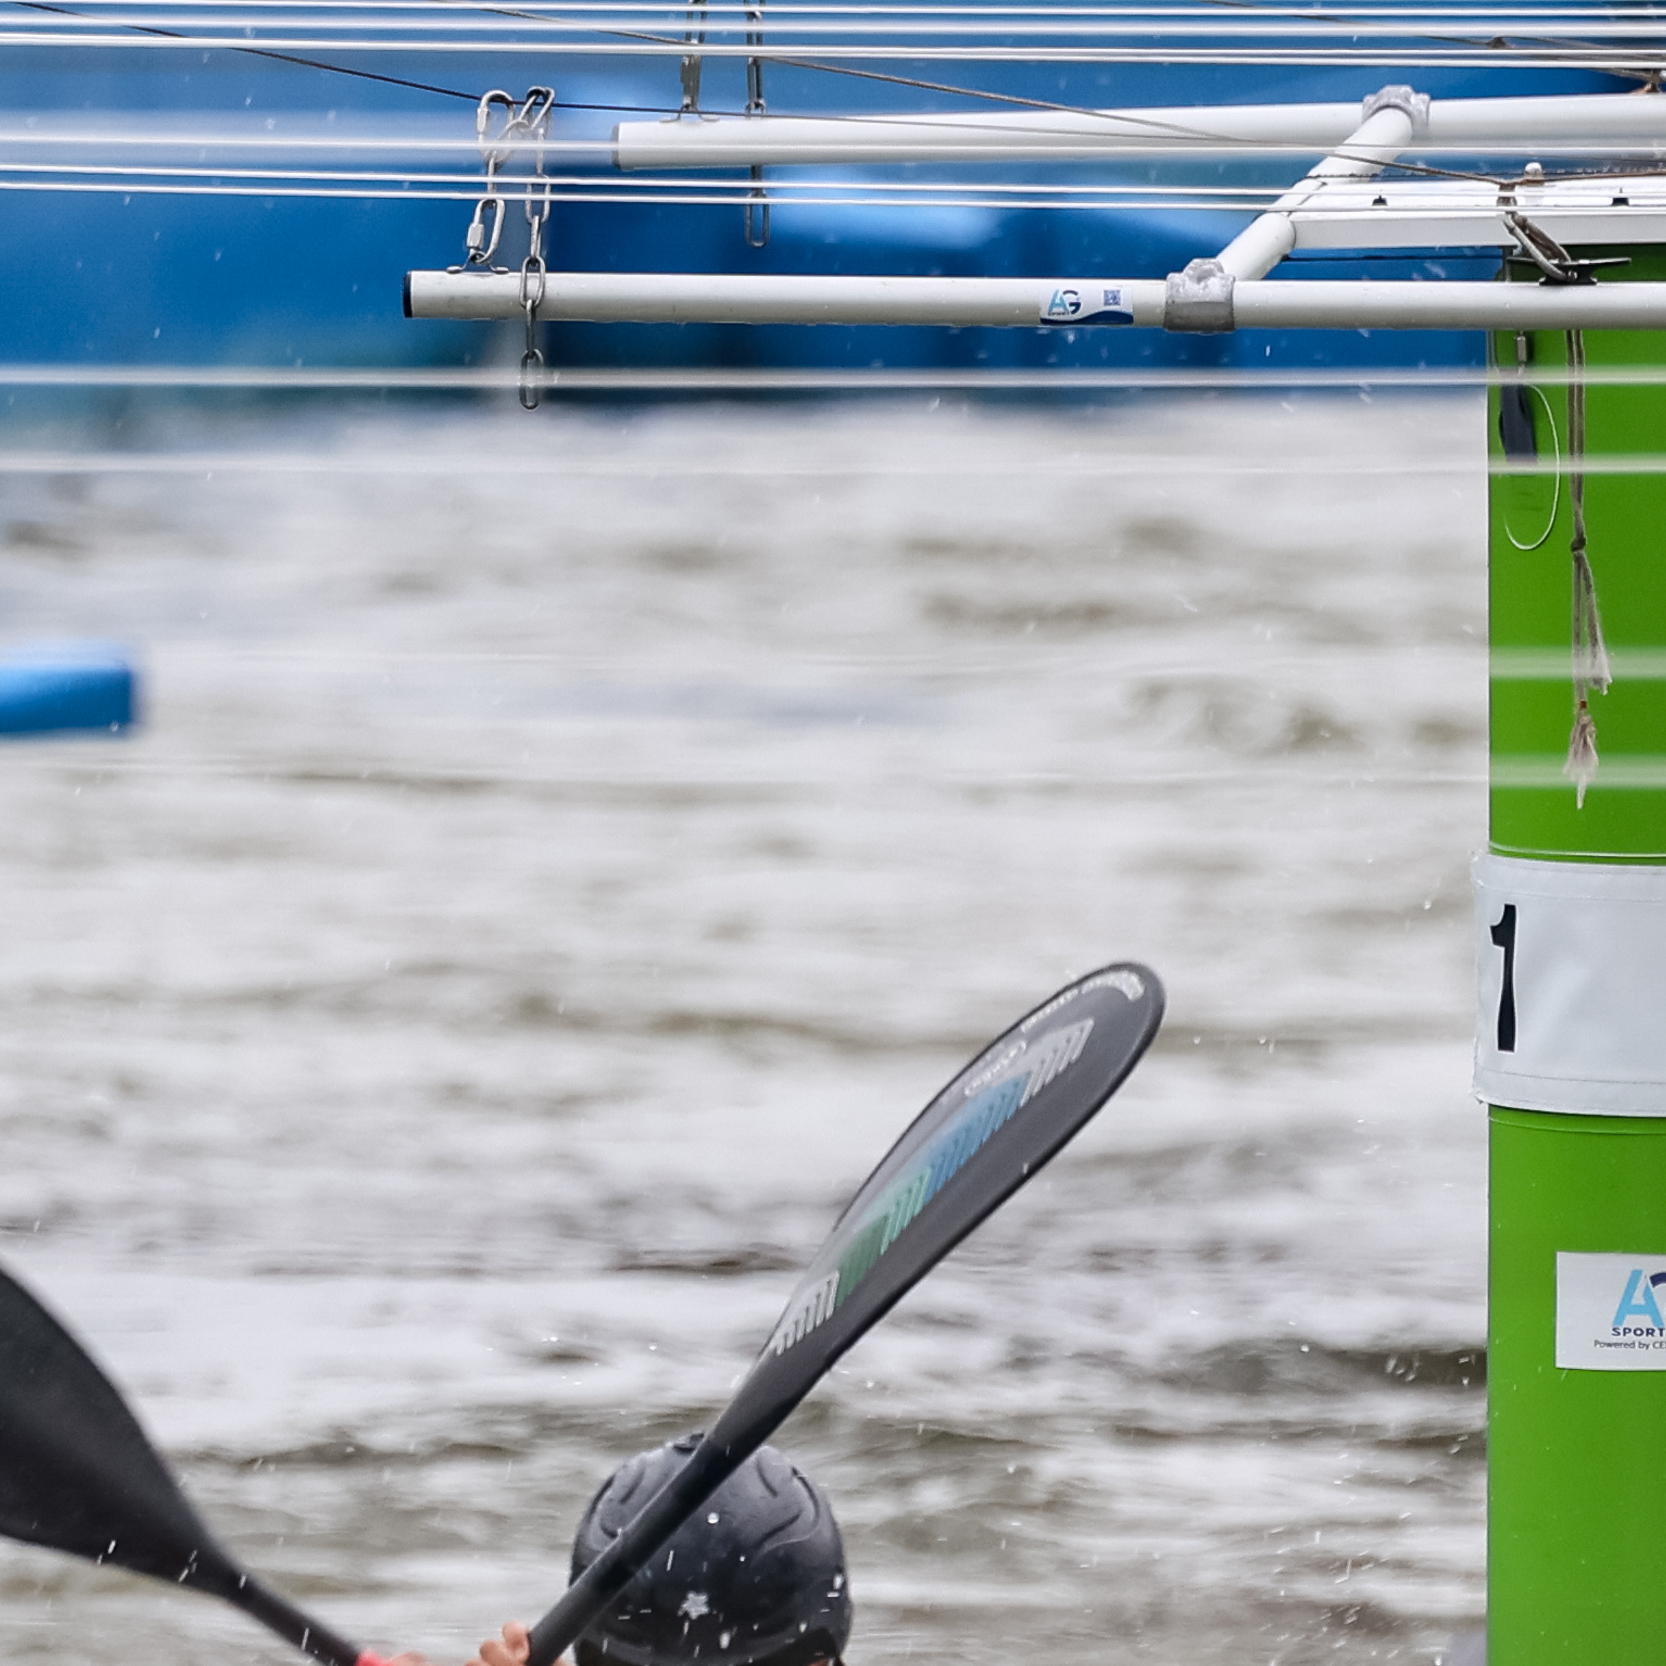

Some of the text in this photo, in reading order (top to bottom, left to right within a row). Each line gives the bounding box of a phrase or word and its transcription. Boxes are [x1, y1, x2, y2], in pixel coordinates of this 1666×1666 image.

[1489, 902, 1516, 1052] 1
[1611, 1327, 1666, 1337] SPORT
[1593, 1339, 1636, 1350] Powered
[1637, 1339, 1651, 1351] by
